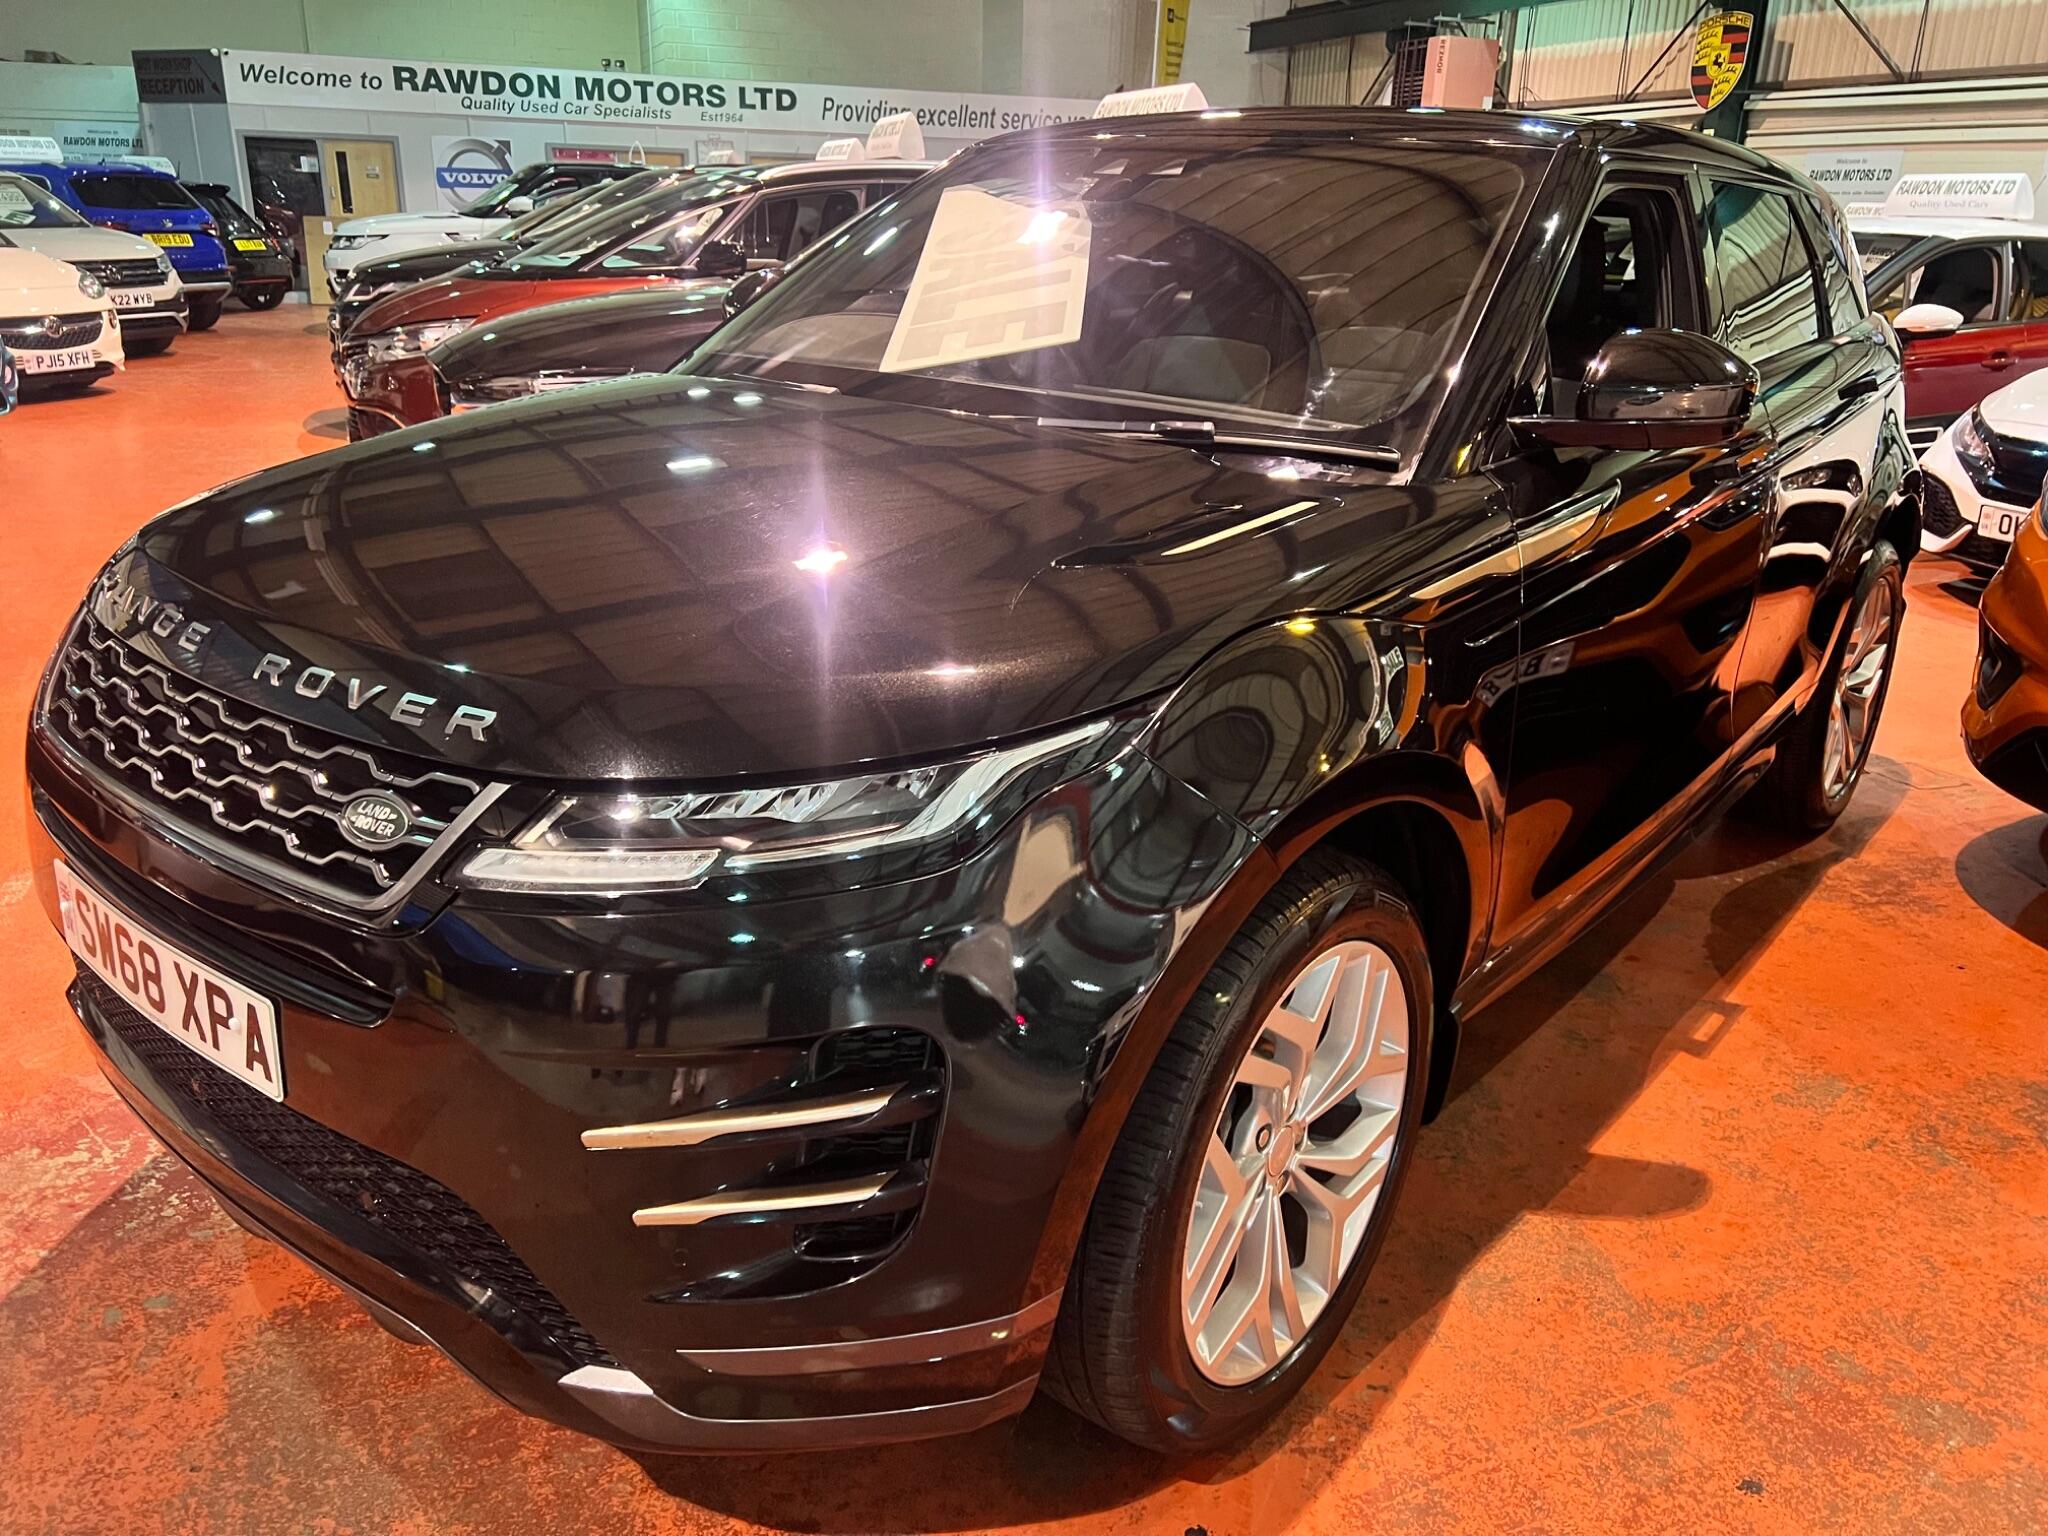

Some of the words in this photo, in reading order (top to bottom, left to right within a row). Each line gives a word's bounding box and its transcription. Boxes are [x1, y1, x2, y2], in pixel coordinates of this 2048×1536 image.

[1698, 13, 1750, 29] PORSCHE
[140, 78, 205, 95] RECEPTION
[239, 62, 352, 88] Welcome
[360, 71, 383, 90] to
[392, 65, 561, 99] RAWDON
[575, 76, 727, 108] MOTORS
[738, 86, 798, 112] LTD
[917, 104, 997, 129] excellent
[461, 95, 515, 114] Quality
[520, 100, 558, 114] Used
[563, 102, 589, 116] Car
[593, 103, 672, 120] Specialists
[700, 111, 743, 123] Est1964
[63, 136, 96, 146] RAWDON
[98, 137, 130, 147] MOTORS
[440, 171, 509, 185] VOLVO
[1809, 169, 1842, 181] RAWDON
[1842, 168, 1876, 181] MOTORS
[1876, 168, 1893, 181] LTD
[1896, 180, 1943, 196] RAWDON
[1944, 180, 1992, 196] MOTORS
[1993, 179, 2017, 196] LTD
[1909, 200, 1941, 210] Quality
[1944, 200, 1966, 208] Used
[1968, 200, 1989, 209] Cars
[133, 293, 153, 305] WYB
[36, 353, 66, 369] PJ15
[67, 351, 90, 366] XFH
[252, 651, 498, 742] ROVER
[356, 800, 392, 820] LAND
[354, 814, 396, 837] ROVER
[75, 888, 166, 1015] SW68
[173, 960, 273, 1084] XPA
